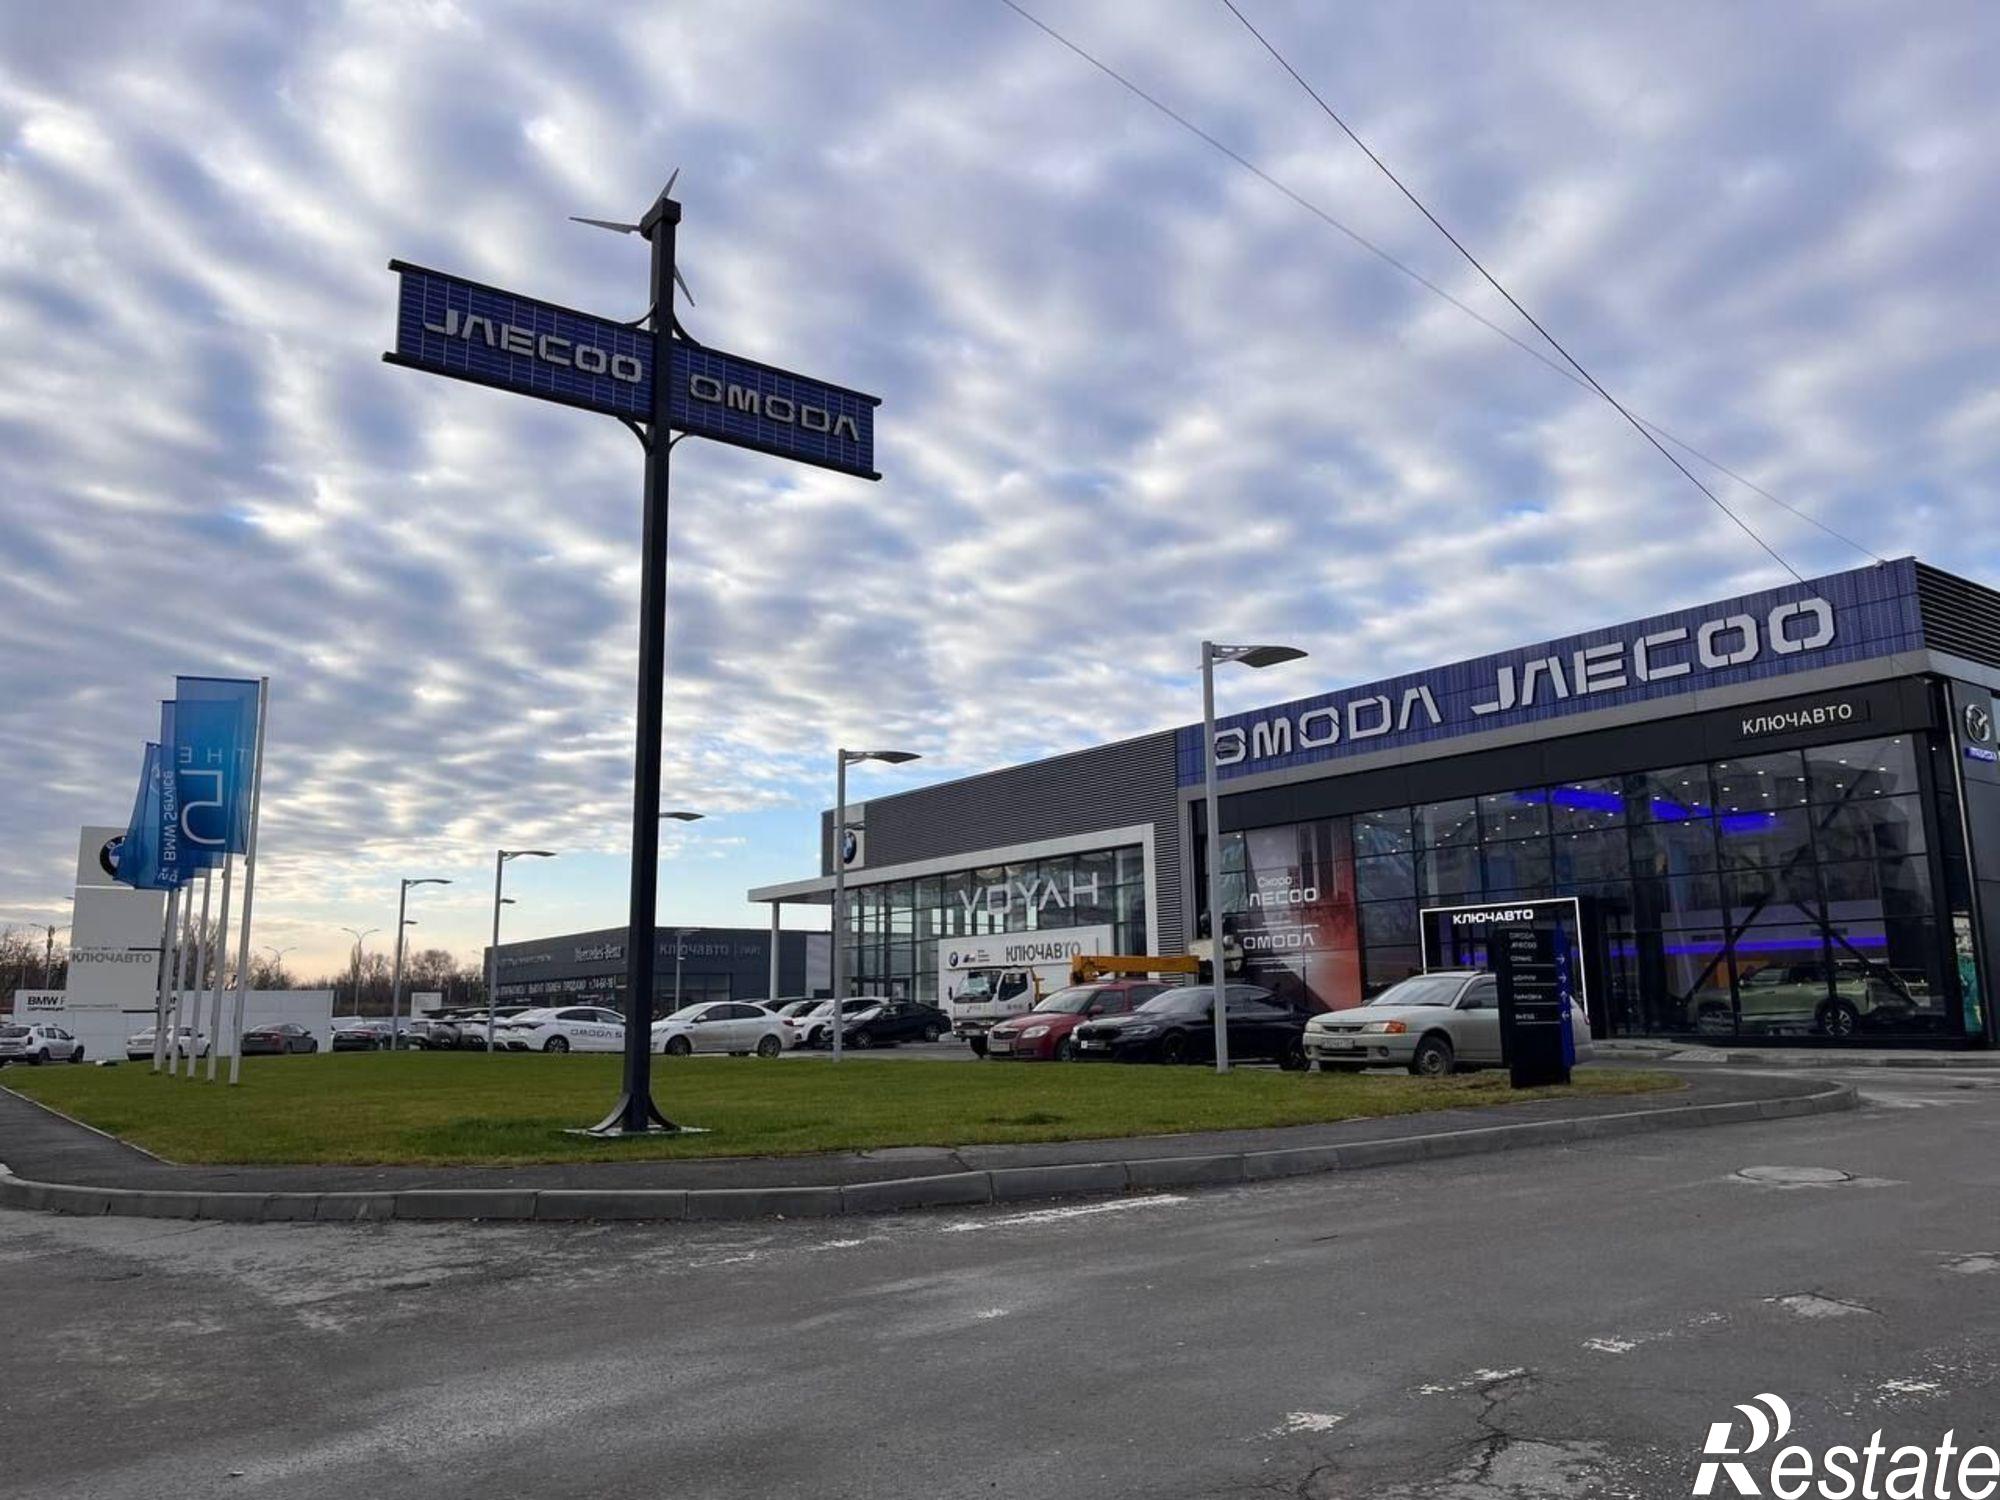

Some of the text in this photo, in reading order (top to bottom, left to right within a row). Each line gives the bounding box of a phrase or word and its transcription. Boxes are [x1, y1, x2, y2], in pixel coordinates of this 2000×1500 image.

[424, 308, 643, 384] JAECOO
[689, 373, 861, 443] OMODA
[1213, 596, 1837, 767] OMODA JAECOO
[1741, 702, 1854, 736] КЛЮЧАВТО
[958, 872, 1099, 917] VOYAH
[1453, 909, 1534, 925] КЛЮЧАВТО
[1005, 941, 1081, 963] КЛЮЧАВТО
[1243, 932, 1316, 950] OMODA
[71, 951, 153, 964] КЛЮЧАВТО
[27, 996, 59, 1006] BMW
